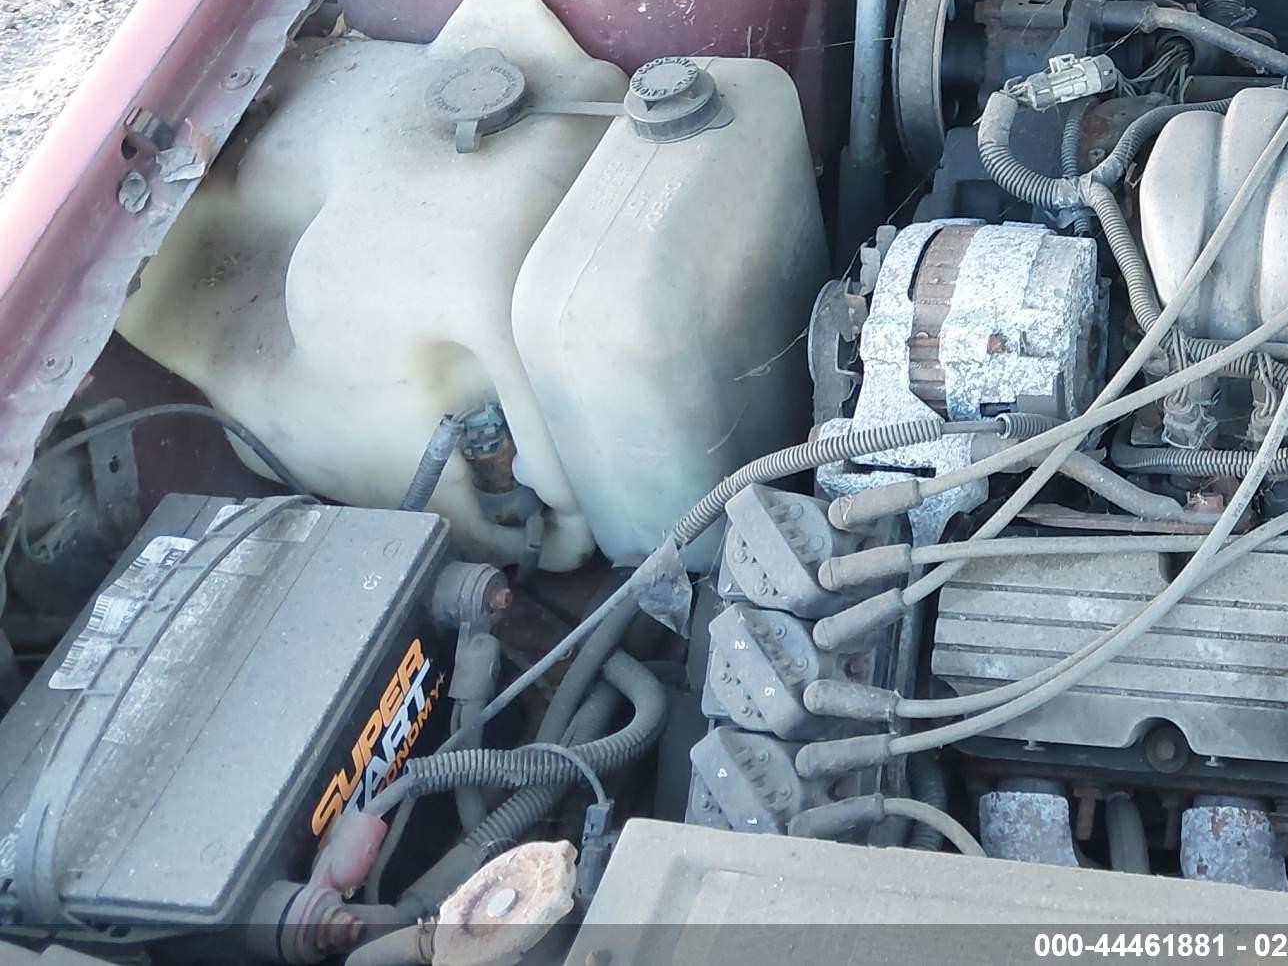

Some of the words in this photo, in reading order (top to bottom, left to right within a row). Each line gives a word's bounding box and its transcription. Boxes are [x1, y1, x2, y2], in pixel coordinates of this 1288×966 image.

[637, 57, 695, 75] COOLANT
[312, 638, 425, 836] SUPER
[342, 658, 431, 814] TART
[716, 767, 729, 779] 4
